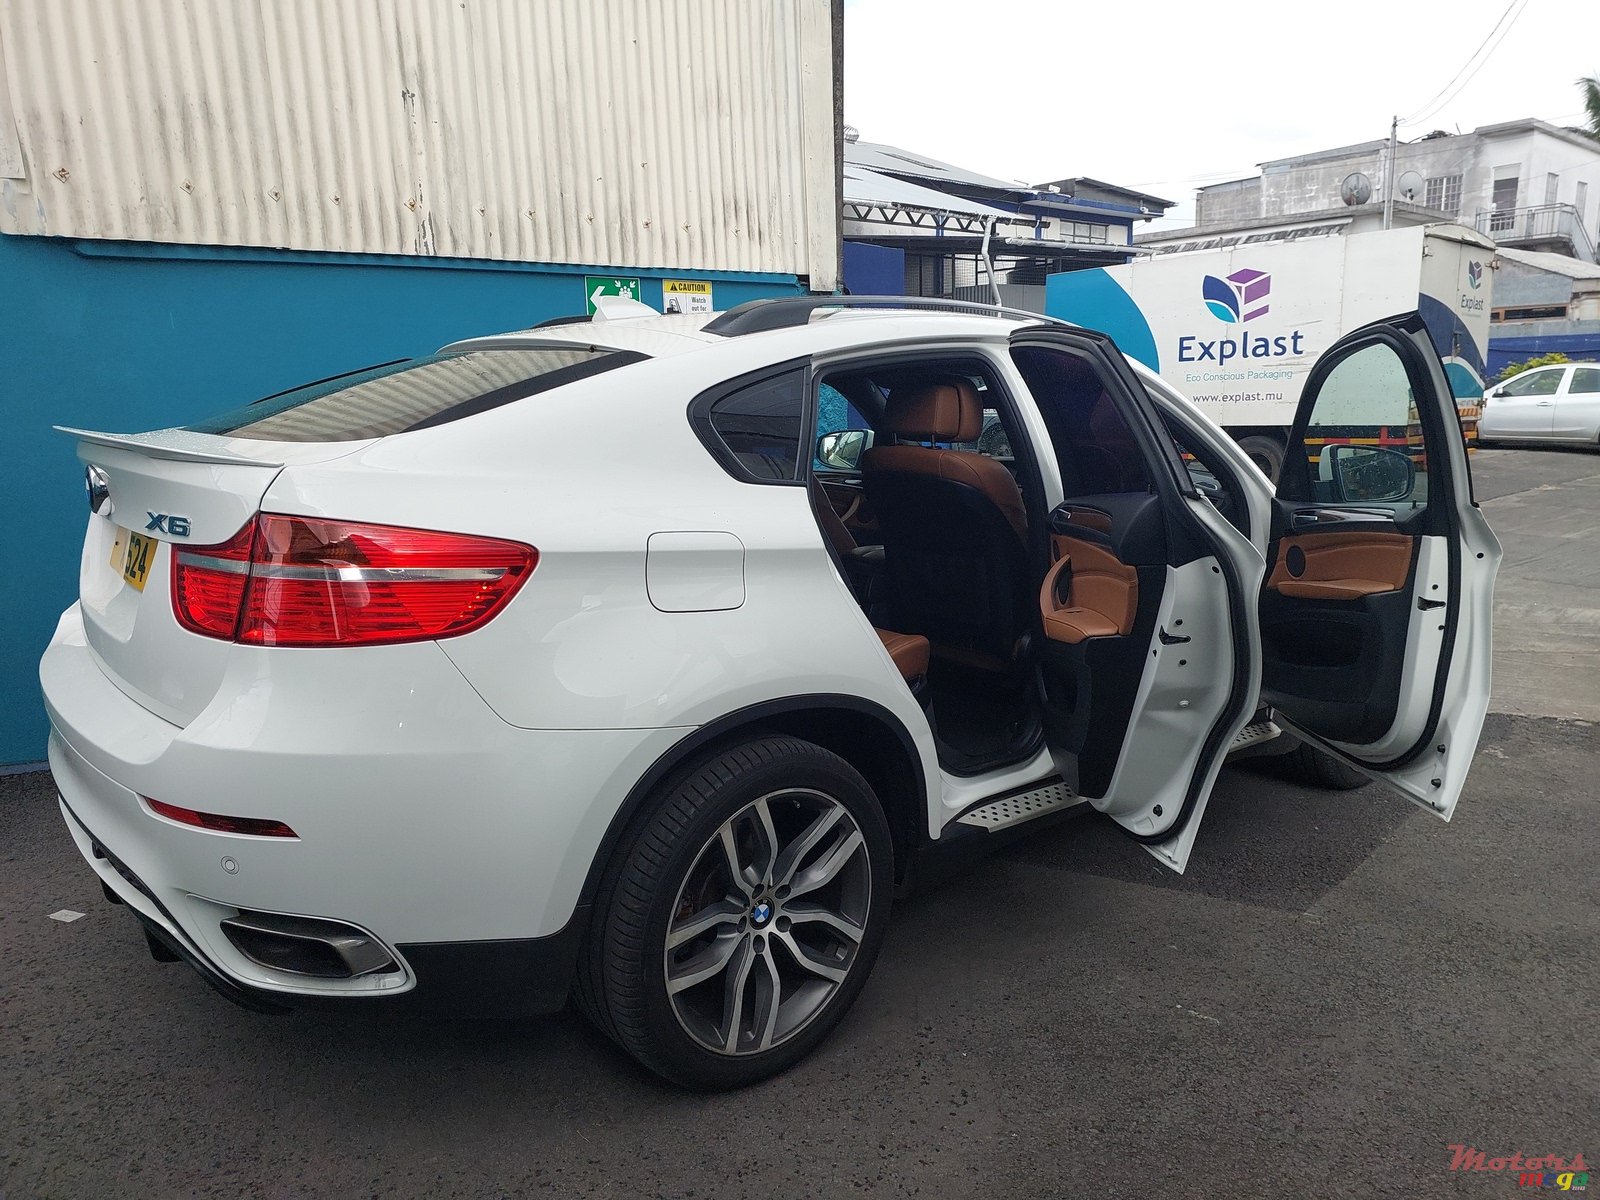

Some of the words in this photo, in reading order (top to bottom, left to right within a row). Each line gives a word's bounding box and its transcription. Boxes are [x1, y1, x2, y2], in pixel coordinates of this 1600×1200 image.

[678, 282, 706, 292] CAUTION
[691, 296, 706, 304] Watch
[1461, 294, 1484, 312] Explast
[1178, 330, 1304, 366] Explast
[1186, 374, 1201, 382] Eco
[1203, 371, 1245, 381] Conscious
[1247, 370, 1293, 380] Packaging
[1193, 392, 1283, 404] www.explast.mu
[145, 511, 192, 537] X6
